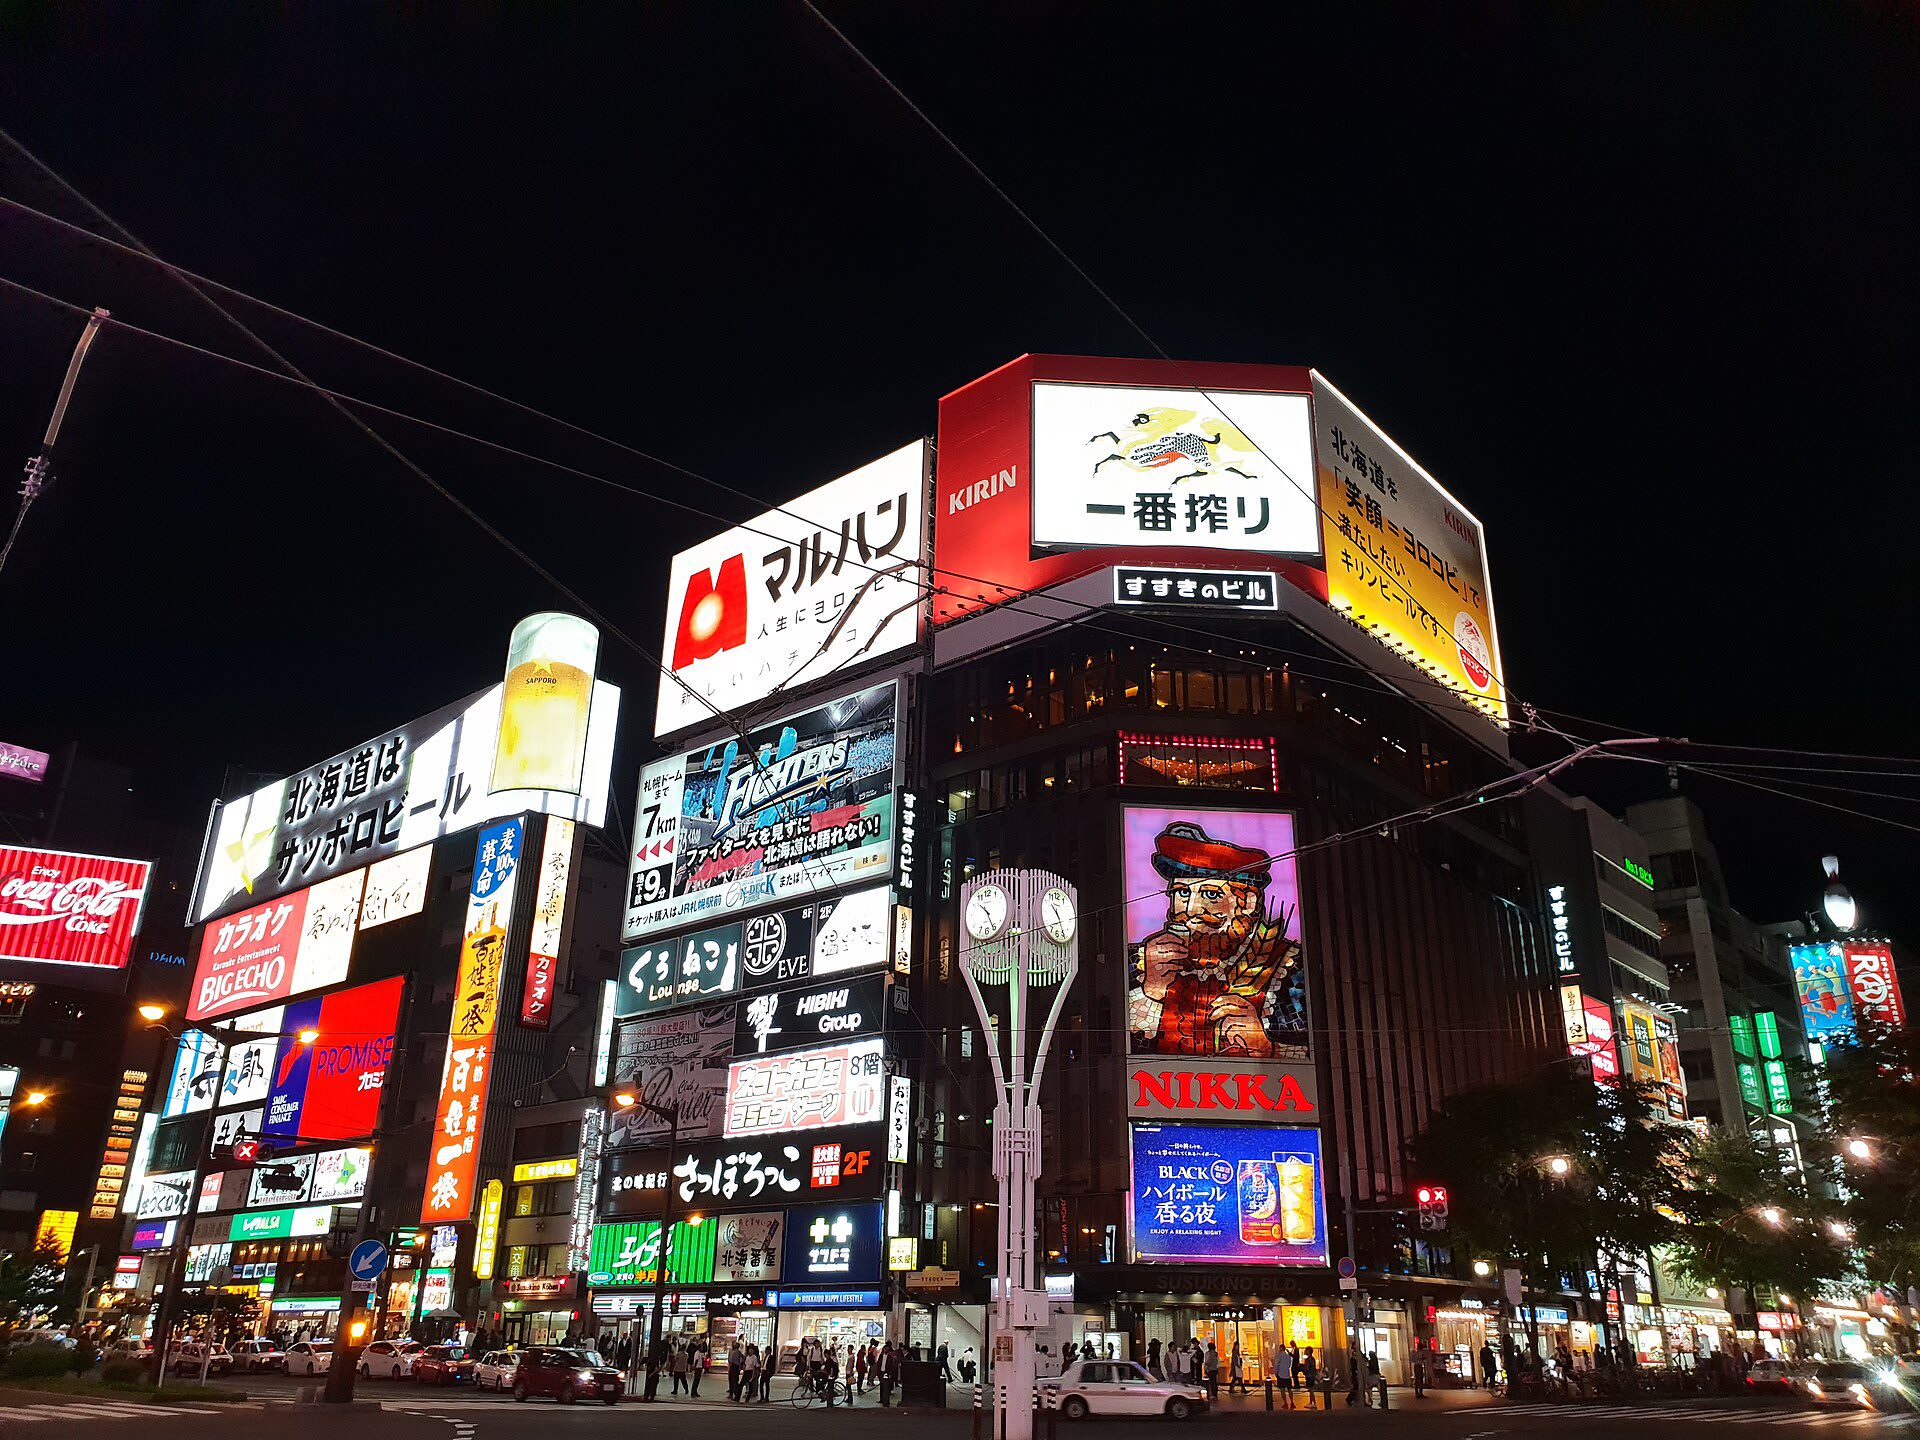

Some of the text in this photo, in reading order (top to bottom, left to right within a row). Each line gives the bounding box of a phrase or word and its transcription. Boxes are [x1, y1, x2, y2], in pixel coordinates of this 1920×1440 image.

[1331, 425, 1398, 501] 北海道を
[949, 465, 1016, 515] KIRIN
[1086, 492, 1269, 534] 一番搾り
[1443, 508, 1476, 547] KIRIN
[763, 492, 907, 603] マルハン
[1338, 510, 1413, 588] 満たしたい、
[1125, 578, 1266, 600] すすきのビル
[1341, 548, 1446, 645] キリンビールです。
[525, 677, 557, 685] SAPPORO
[284, 737, 404, 824] 北海道は
[643, 770, 682, 793] 札幌ドーム
[712, 736, 850, 840] FIGHTERS
[655, 787, 669, 799] まで
[276, 772, 471, 884] サッポロビール
[686, 816, 811, 867] ファイターズを見ずに
[901, 793, 916, 888] すすきのビル
[32, 866, 61, 878] Enjoy
[476, 838, 498, 895] 革命
[780, 872, 800, 887] または
[802, 908, 813, 919] 8F
[819, 905, 833, 919] 2F
[65, 915, 109, 934] Coke
[213, 903, 293, 955] カラオケ
[1549, 885, 1574, 972] すすきのビル
[212, 944, 280, 972] Karaoke Entertainment
[777, 955, 809, 979] EVE
[530, 957, 550, 1014] カラオケ
[649, 979, 699, 1001] Lounge
[796, 989, 850, 1016] HIBIKI
[818, 1012, 862, 1033] Group
[316, 1034, 394, 1078] PROMISE
[851, 1052, 880, 1076] 8階
[1131, 1070, 1315, 1112] NIKKA
[268, 1112, 292, 1124] FINANCE
[270, 1102, 299, 1115] CONSUMER
[843, 1150, 871, 1175] 2F
[1158, 1166, 1209, 1180] BLACK
[611, 1172, 668, 1192] 北の味紀行
[1141, 1183, 1228, 1202] ハイボール
[1153, 1201, 1218, 1225] 香る夜
[721, 1248, 776, 1267] 北海番屋
[1157, 1275, 1249, 1291] SUSUKINO
[825, 1294, 839, 1303] HAPPY
[840, 1294, 863, 1303] LIFESTYLE
